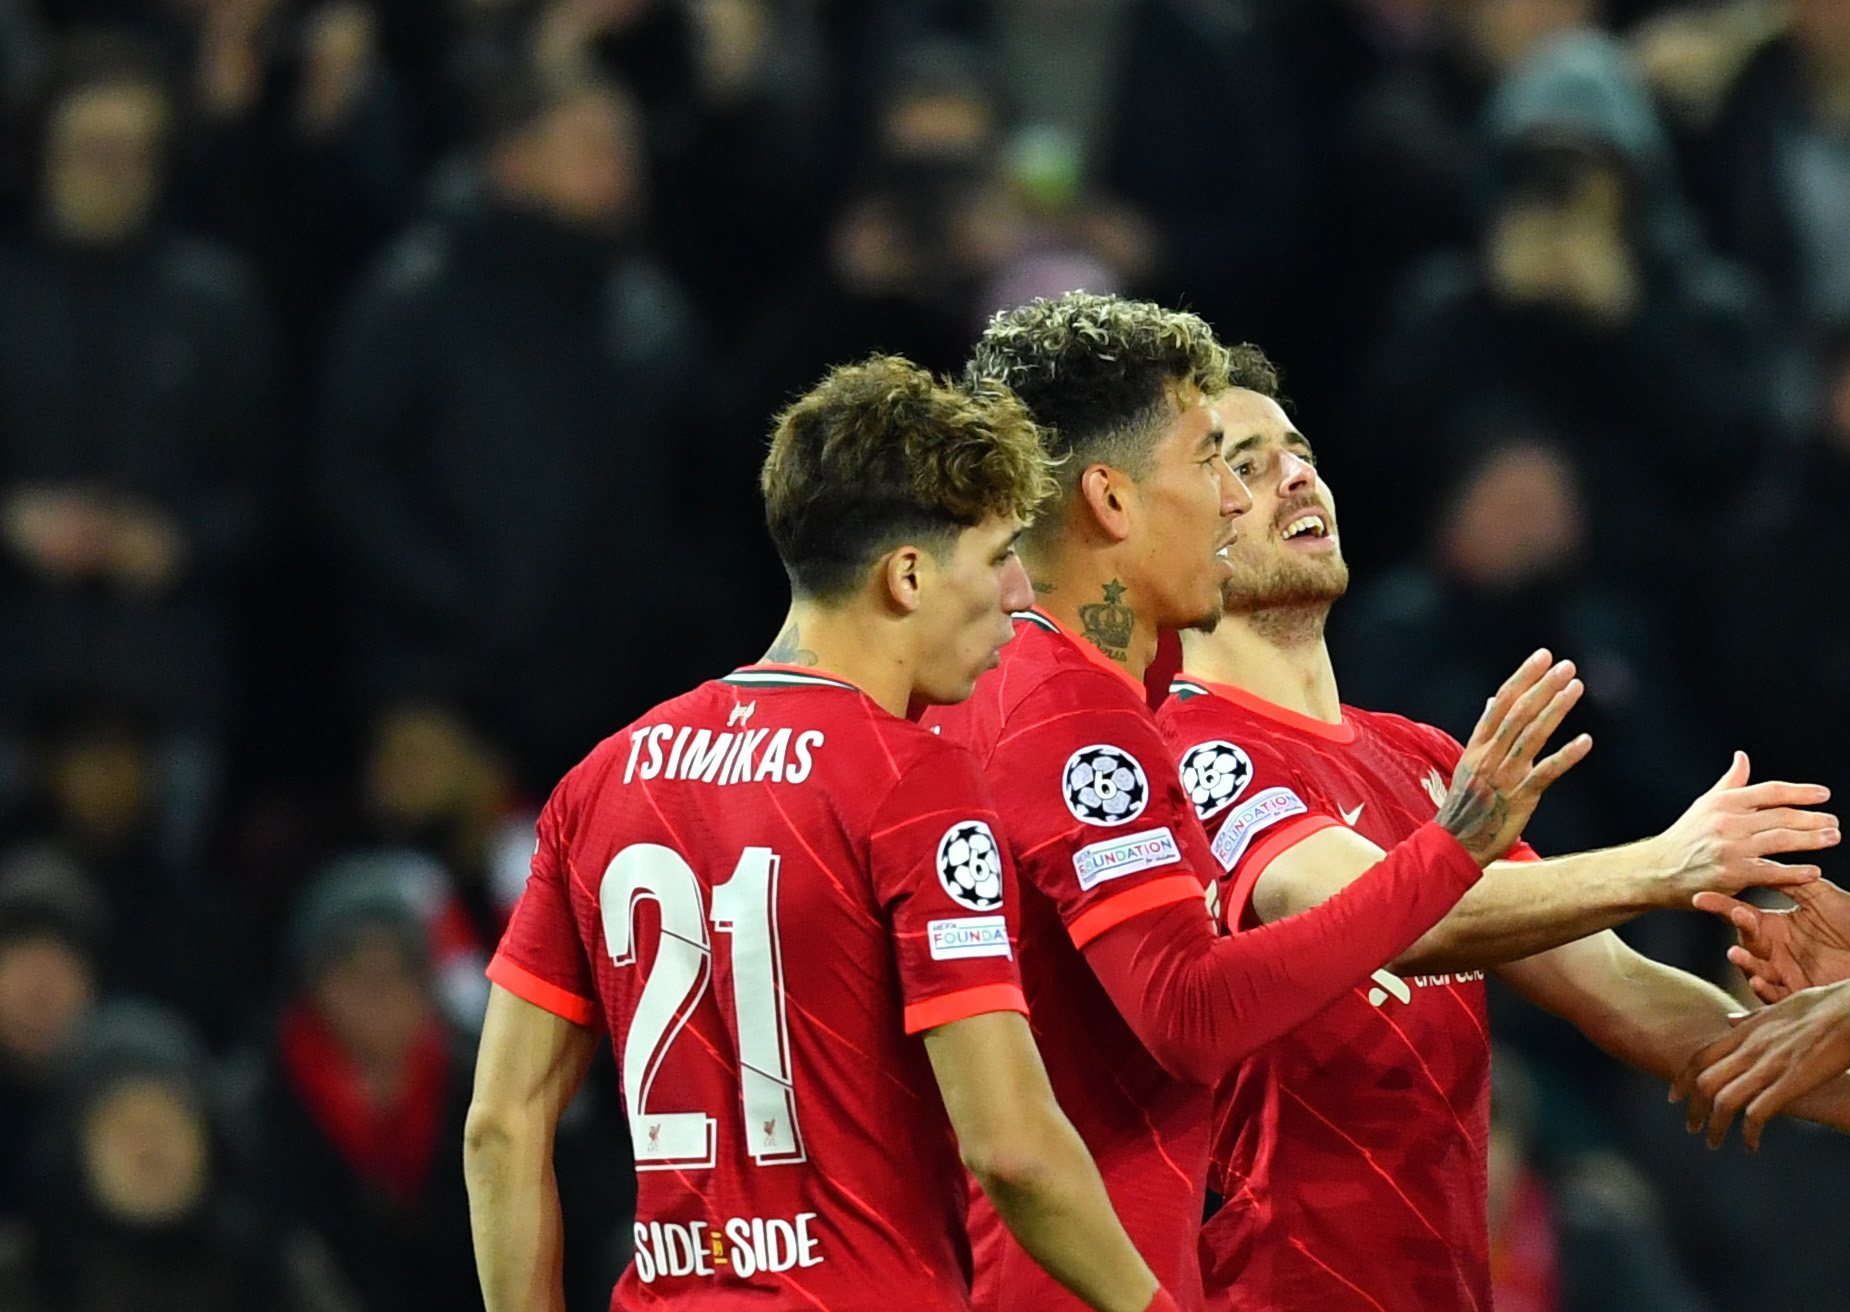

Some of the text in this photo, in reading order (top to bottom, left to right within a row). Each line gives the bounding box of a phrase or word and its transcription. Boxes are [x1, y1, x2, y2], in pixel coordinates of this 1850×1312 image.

[622, 723, 824, 786] TSIMIKAS
[1093, 769, 1118, 800] 6
[1078, 838, 1173, 874] FOUNDATION
[1219, 794, 1299, 862] FOUNDATION
[968, 847, 991, 883] 6
[600, 842, 808, 1172] 21
[634, 1221, 716, 1284] SIDE
[725, 1212, 825, 1279] SIDE
